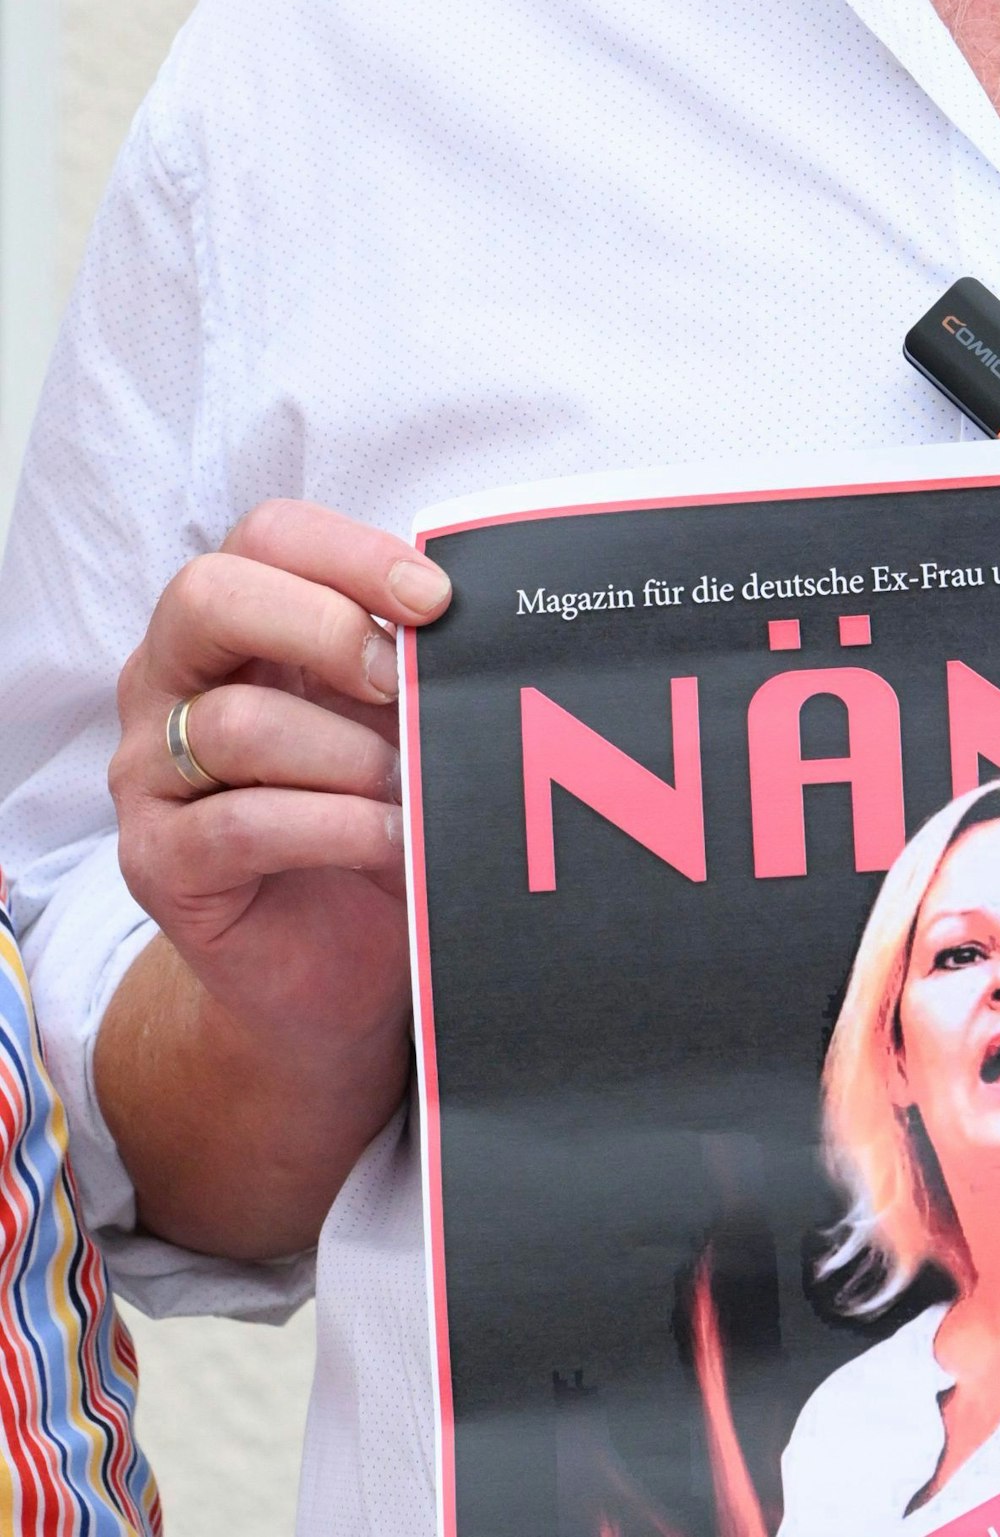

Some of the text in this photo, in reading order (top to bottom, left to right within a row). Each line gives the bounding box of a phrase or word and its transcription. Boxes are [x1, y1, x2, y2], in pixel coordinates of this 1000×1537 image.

[516, 583, 636, 621] Magazin
[642, 578, 685, 607] für
[691, 575, 735, 604] die
[741, 565, 865, 601] deutsche
[871, 562, 985, 593] Ex-Frau
